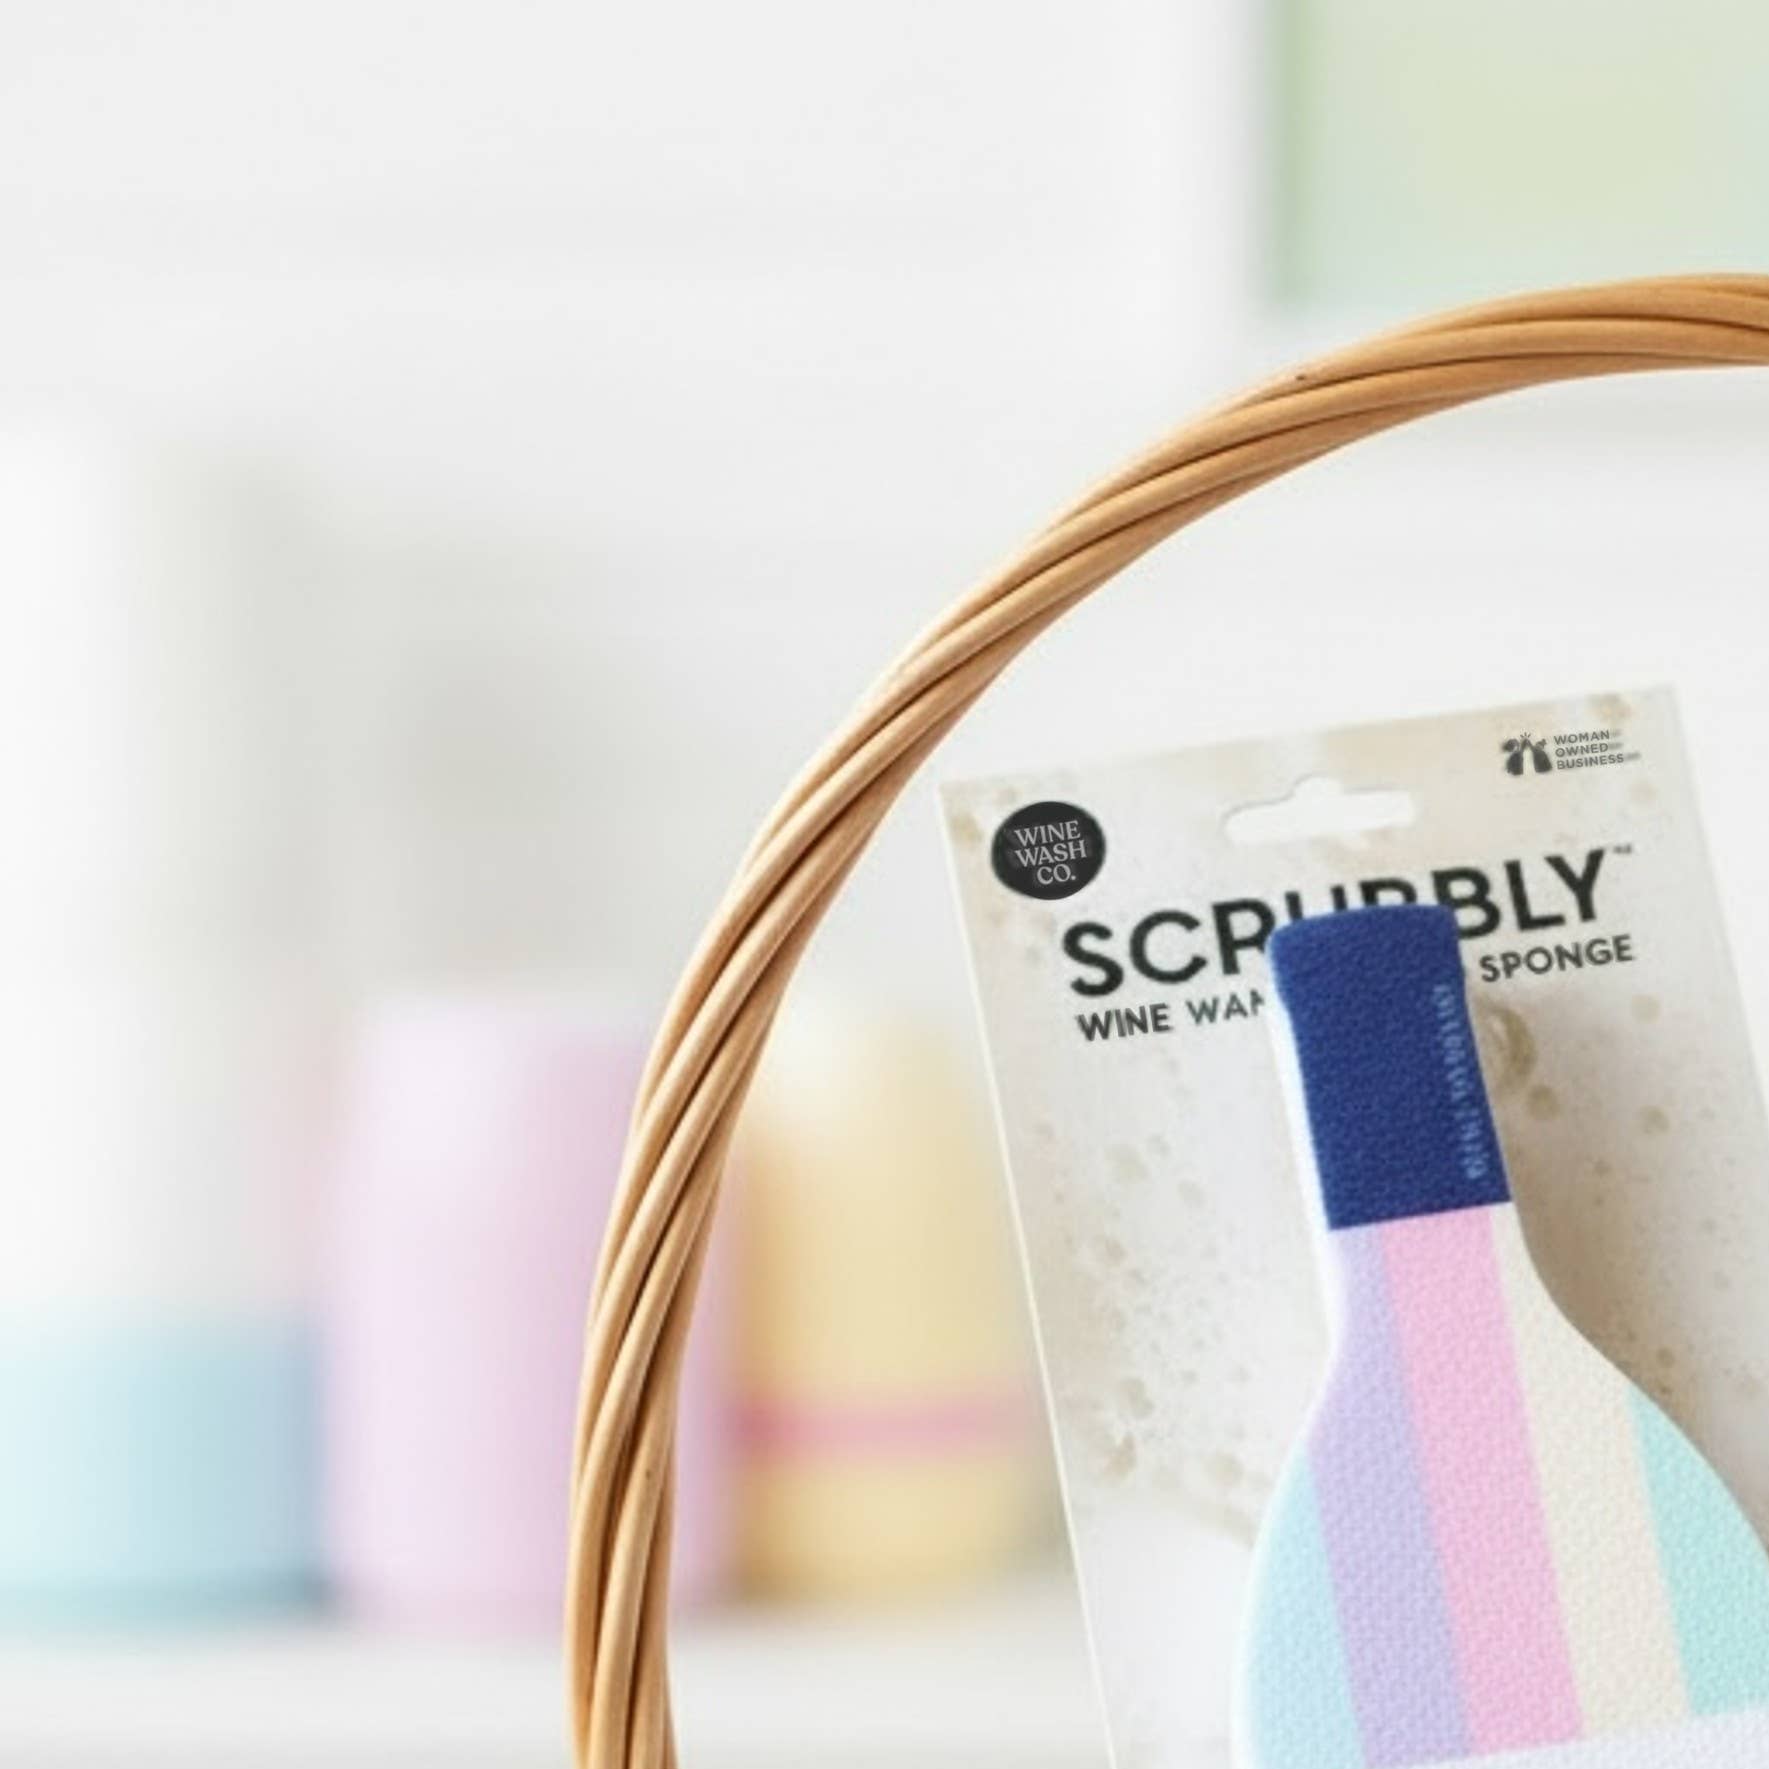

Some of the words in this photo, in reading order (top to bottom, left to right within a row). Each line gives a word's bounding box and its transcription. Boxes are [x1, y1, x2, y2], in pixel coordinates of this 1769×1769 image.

[1553, 729, 1610, 745] WOMAN
[1554, 742, 1609, 758] OWNED
[1556, 753, 1625, 770] BUSINESS
[1014, 820, 1081, 847] WINE
[1014, 839, 1087, 867] WASH
[1037, 863, 1077, 885] CO.
[1076, 1003, 1171, 1041] WINE
[1480, 935, 1634, 983] SPONGE
